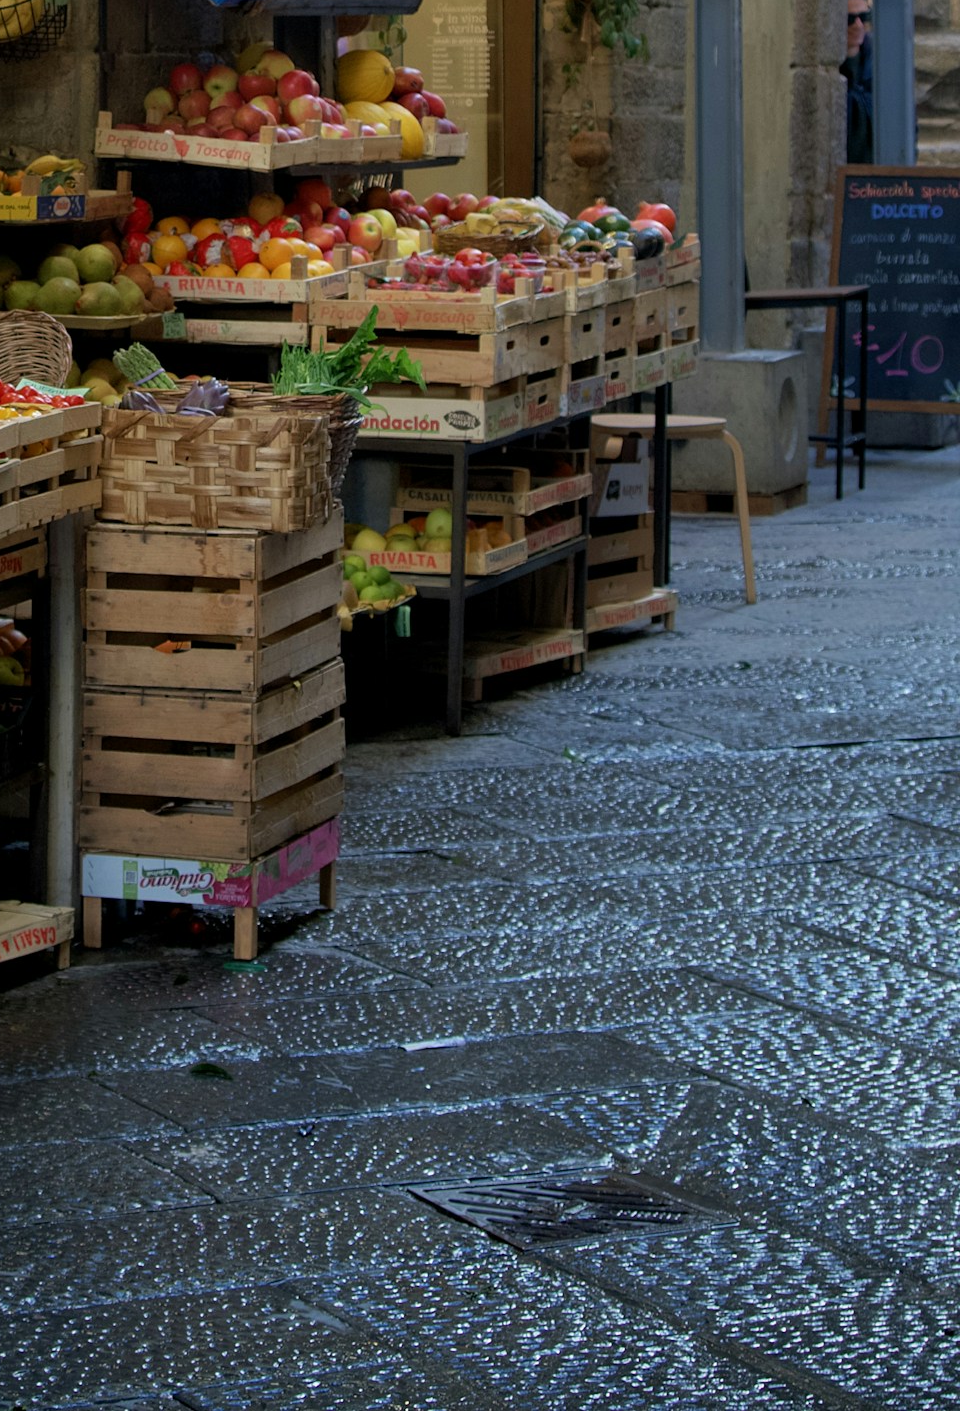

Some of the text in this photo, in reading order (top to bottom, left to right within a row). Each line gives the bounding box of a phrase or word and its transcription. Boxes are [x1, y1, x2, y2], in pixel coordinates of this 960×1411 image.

[106, 134, 250, 162] Prodotto Toscano
[871, 203, 944, 220] DOLCETTO
[179, 279, 246, 295] RIVALTA
[408, 490, 451, 503] CASALI
[370, 553, 437, 569] RIVALTA
[139, 871, 215, 893] Giuliano
[12, 926, 56, 952] CASALI
